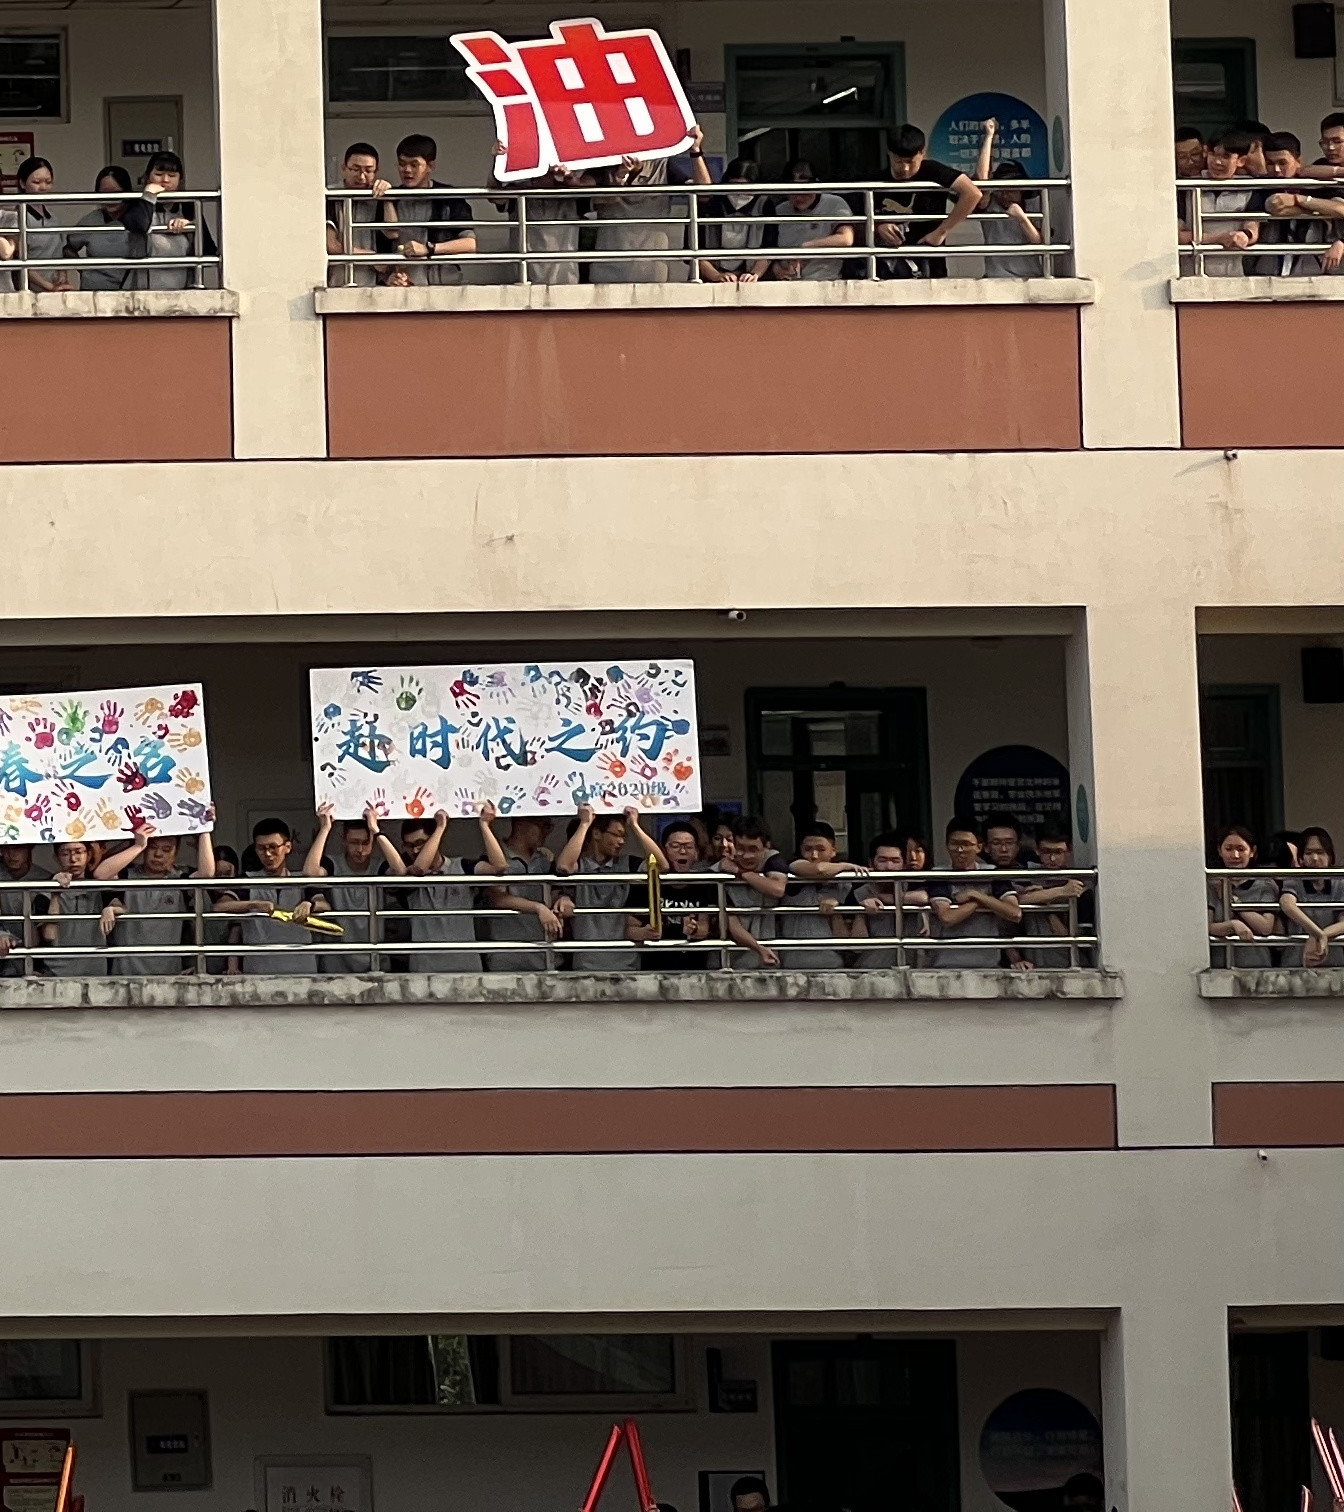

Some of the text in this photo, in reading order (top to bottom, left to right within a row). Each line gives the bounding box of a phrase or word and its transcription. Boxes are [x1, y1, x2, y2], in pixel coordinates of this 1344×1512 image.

[456, 20, 693, 176] 油
[336, 710, 672, 774] 赴时代之约
